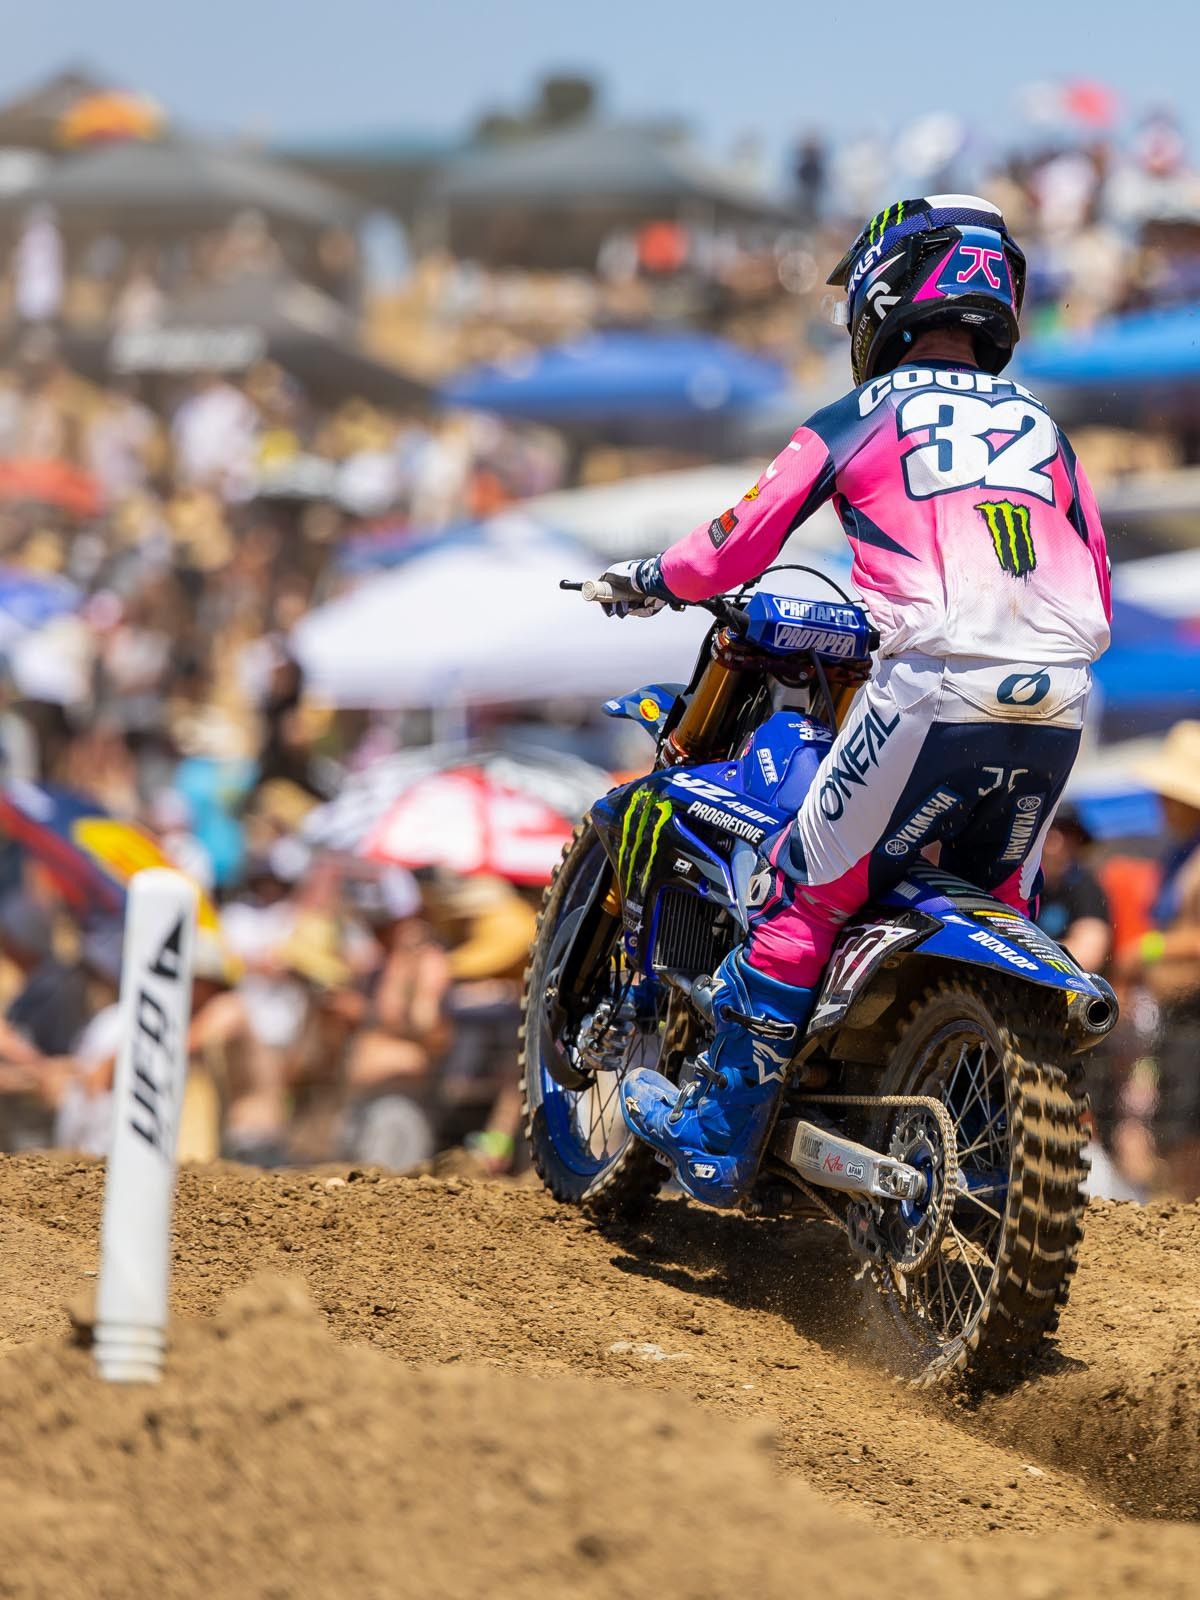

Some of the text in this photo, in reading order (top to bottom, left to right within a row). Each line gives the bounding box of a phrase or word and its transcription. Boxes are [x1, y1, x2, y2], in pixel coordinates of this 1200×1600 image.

[901, 391, 1058, 502] 32
[780, 600, 855, 626] PROTAPER
[777, 625, 854, 657] PROTAPER
[799, 727, 833, 743] 32
[687, 800, 766, 844] PROGRESSIVE
[896, 791, 957, 843] YAMAHA
[1001, 810, 1038, 861] YAMAHA
[968, 930, 1040, 971] DUNLOP
[823, 1151, 844, 1173] Kite
[848, 1166, 862, 1175] AFAM
